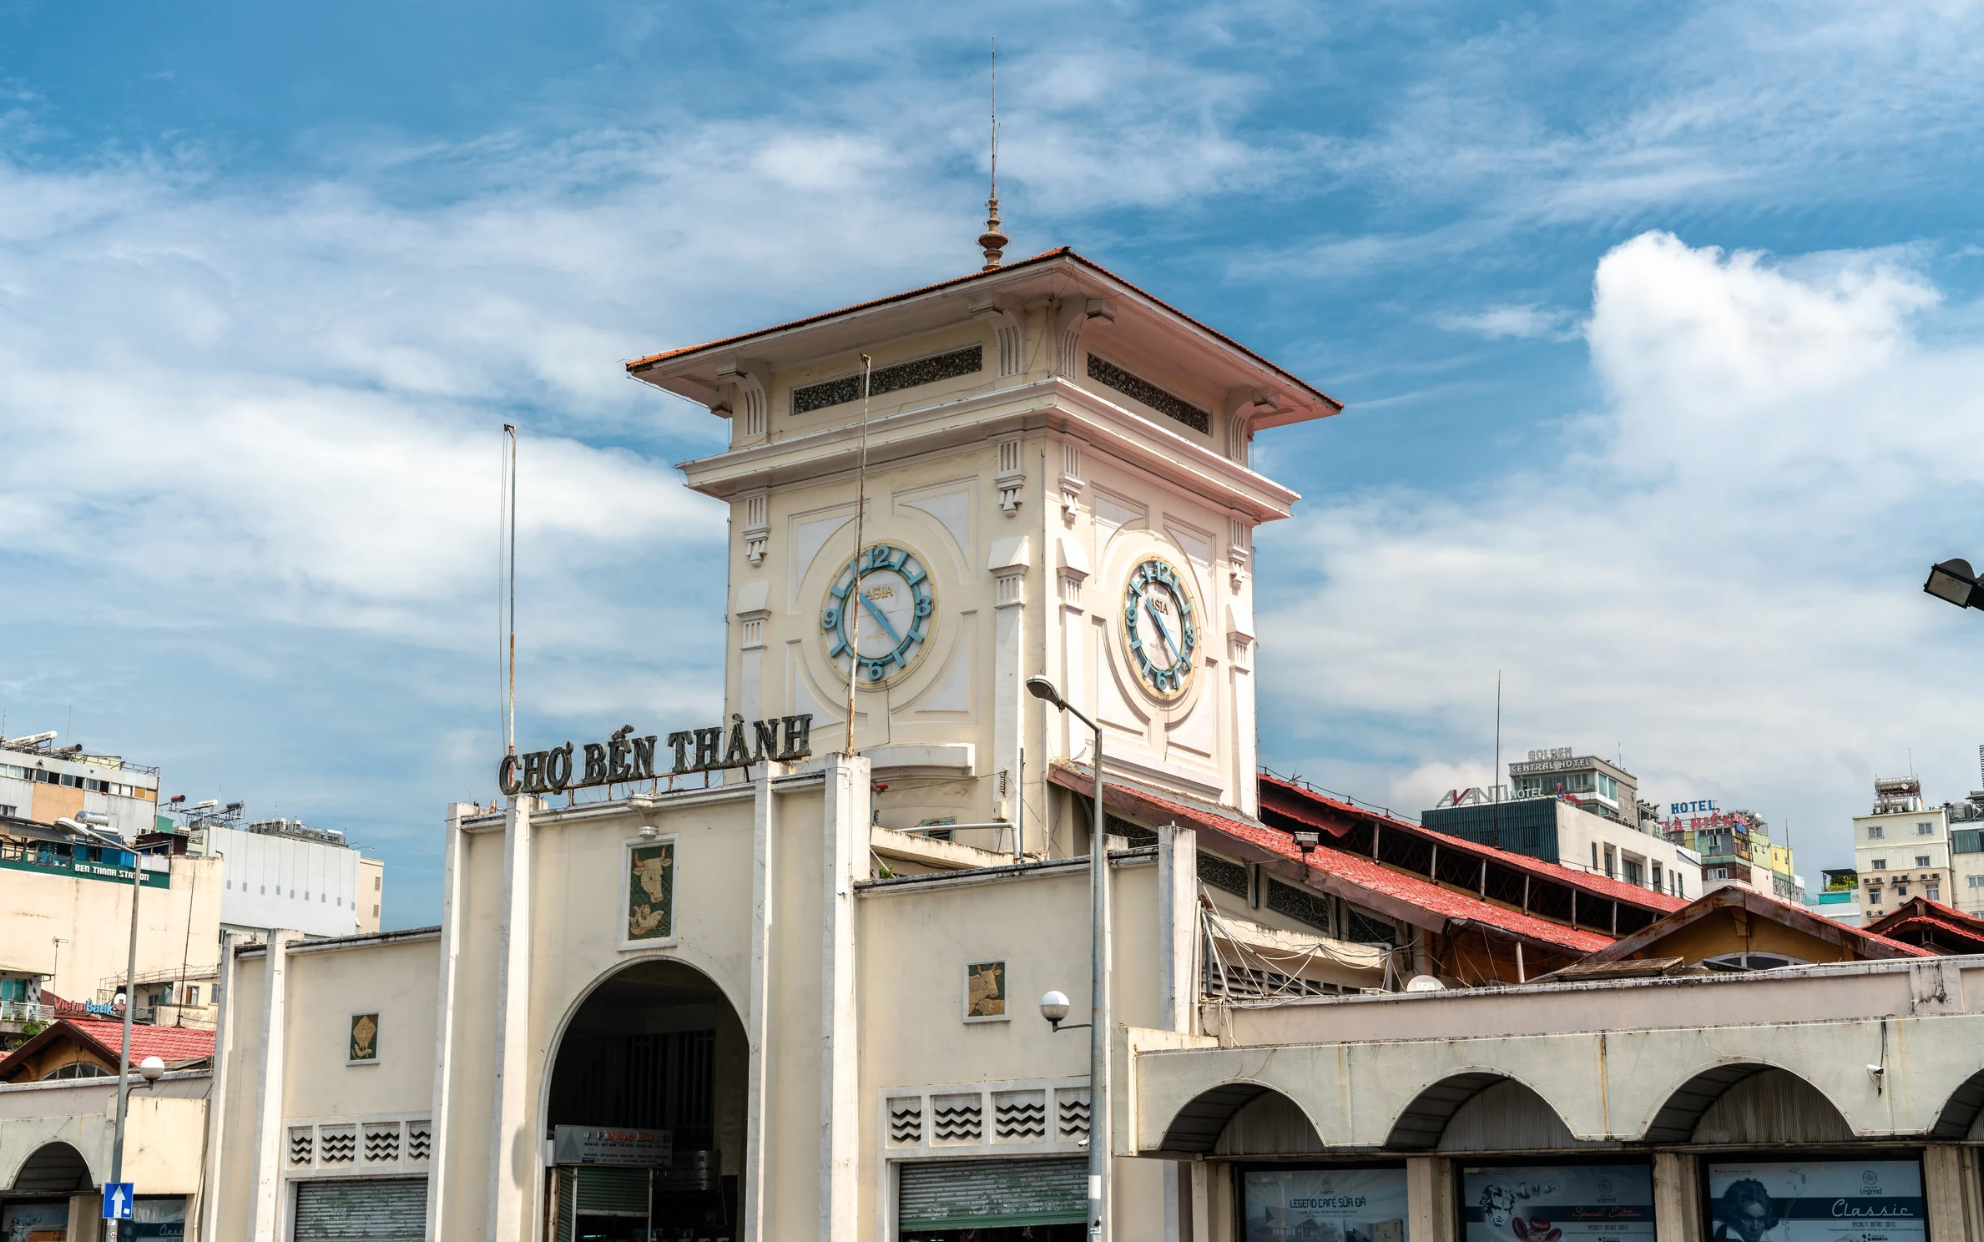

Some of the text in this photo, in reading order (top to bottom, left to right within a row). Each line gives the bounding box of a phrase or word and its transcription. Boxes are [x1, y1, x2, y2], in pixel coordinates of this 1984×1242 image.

[866, 545, 890, 569] 12
[865, 585, 894, 600] ASIA
[498, 713, 814, 795] CHỢ BẾN THÀNH
[1528, 746, 1573, 762] GOLDEN
[1511, 758, 1592, 773] CENTRAL HOTEL
[1436, 784, 1509, 808] AVANTI
[1510, 787, 1545, 800] HOTEL
[1671, 799, 1716, 814] HOTEL
[74, 863, 90, 873] BEN
[92, 866, 117, 877] THANH
[53, 997, 114, 1015] VietinBank
[1289, 1199, 1317, 1209] LEGEND
[1318, 1196, 1337, 1208] CAFÉ
[1338, 1195, 1354, 1208] SỮA
[1832, 1198, 1914, 1217] Classic
[1572, 1206, 1643, 1221] Special Edition
